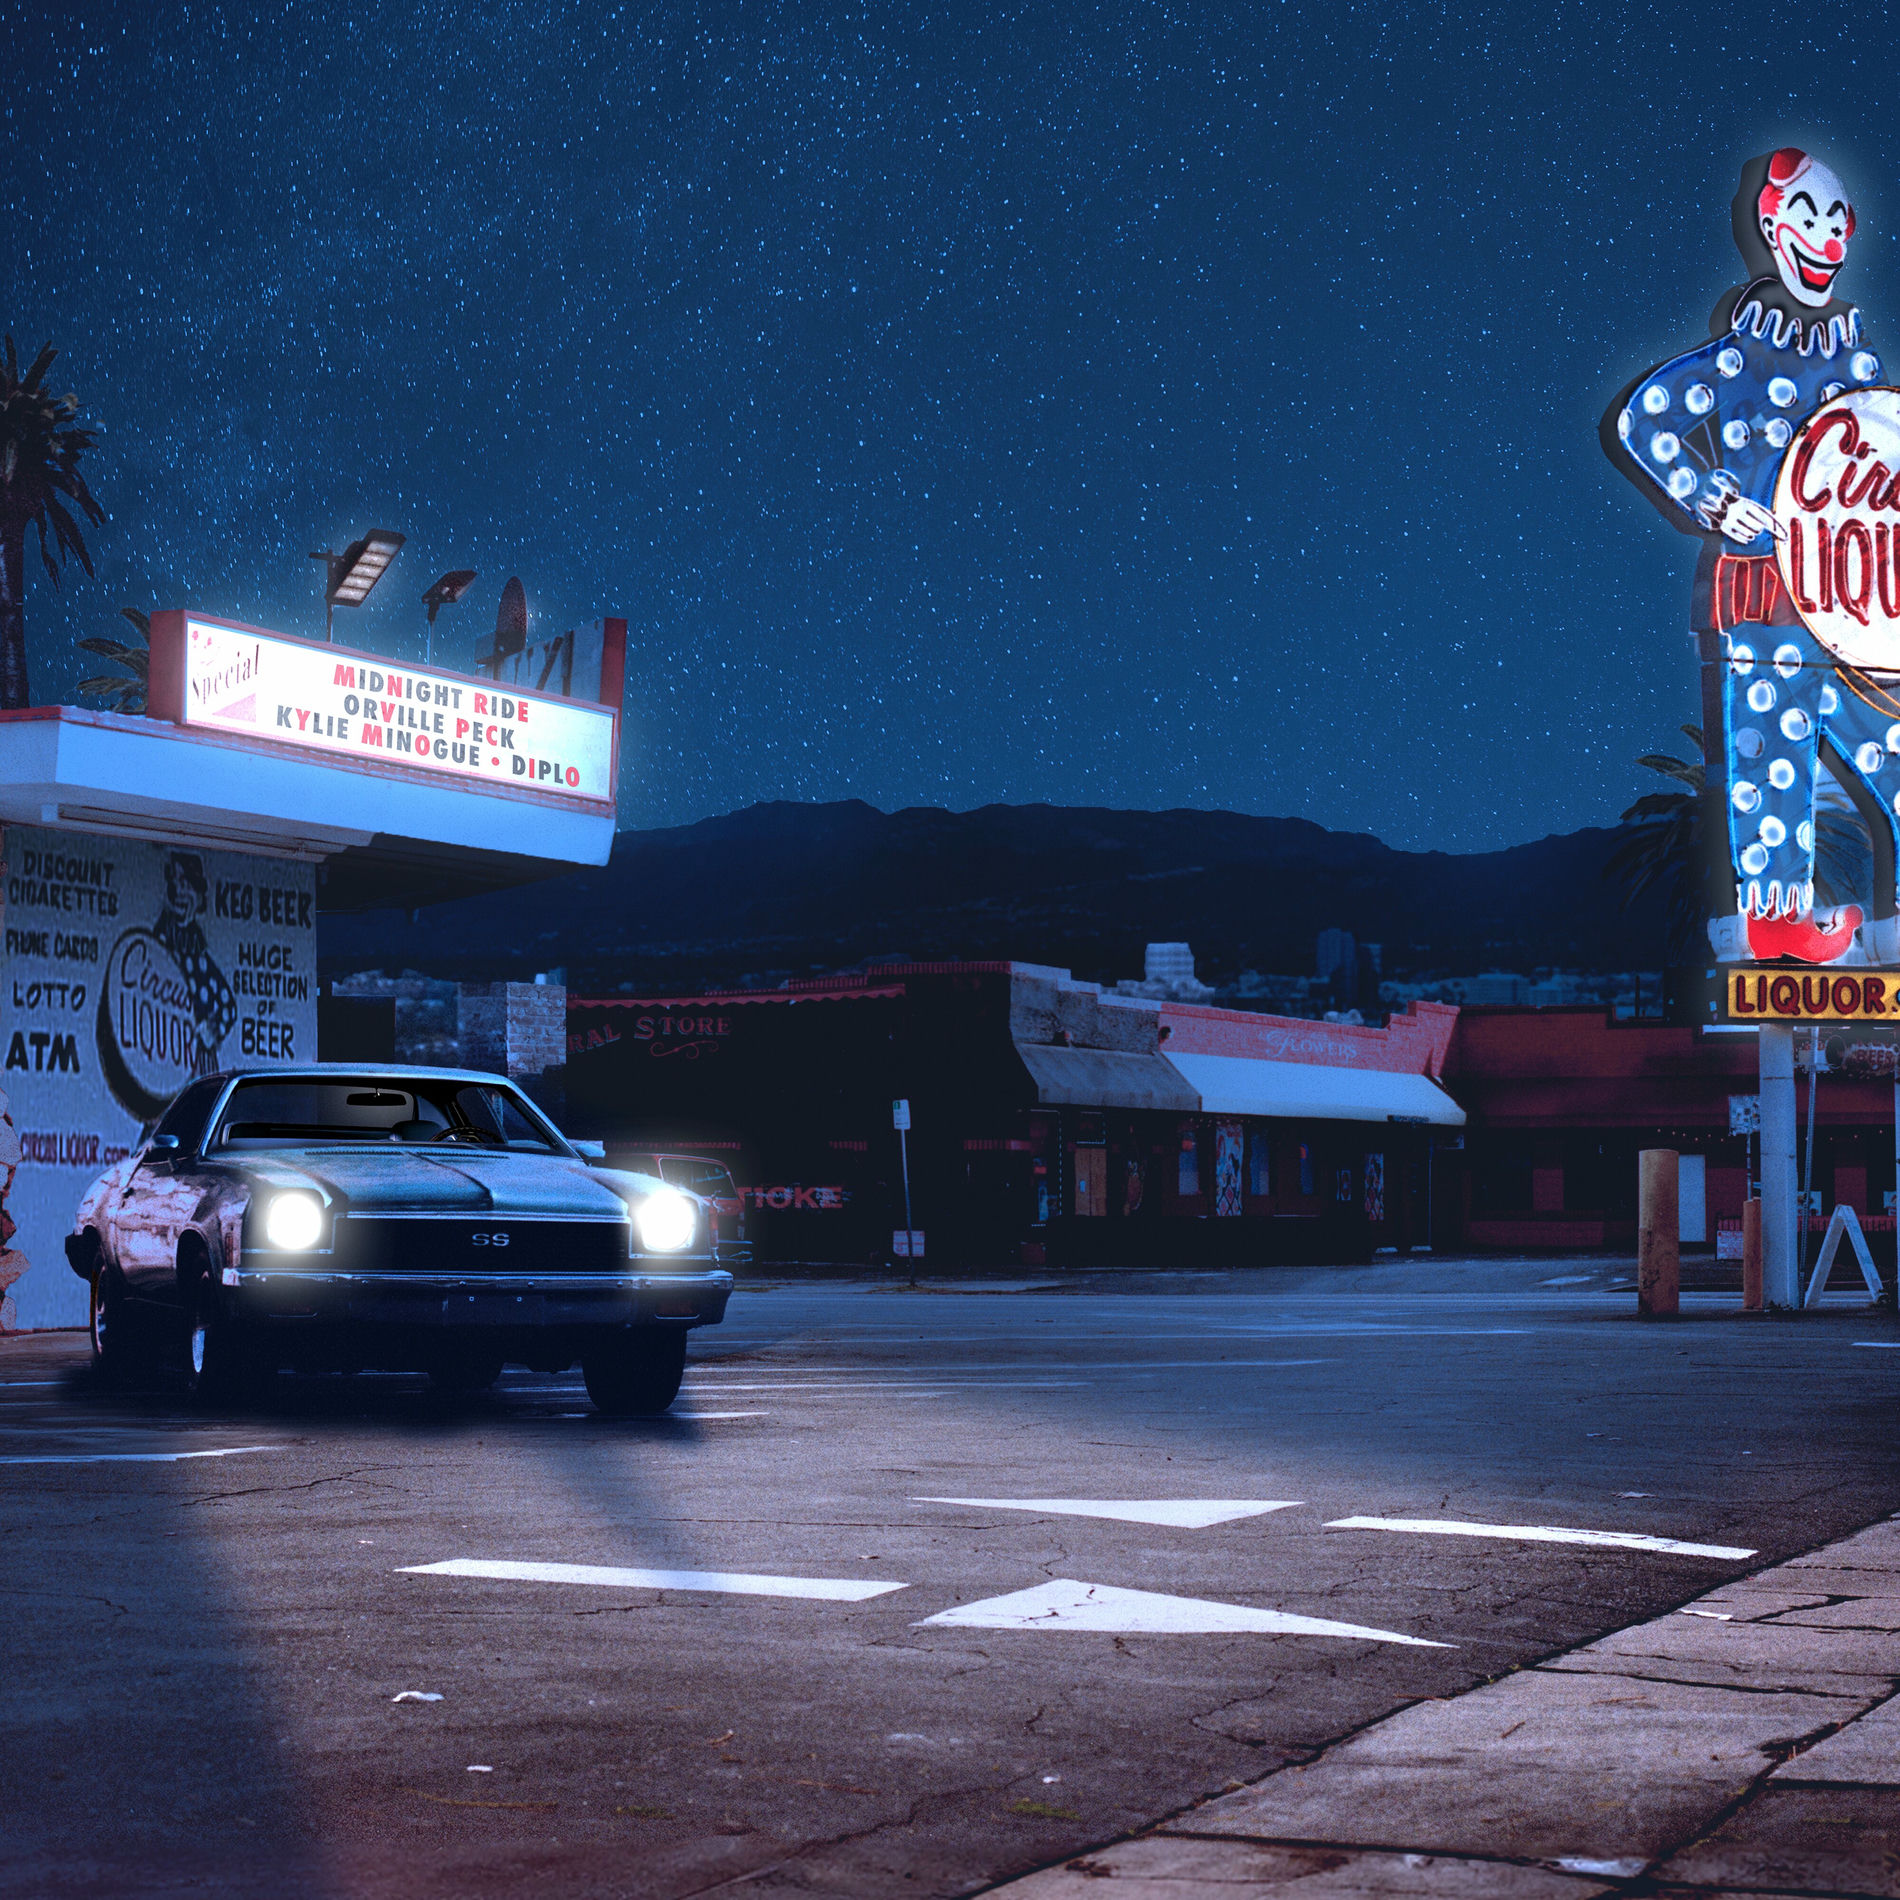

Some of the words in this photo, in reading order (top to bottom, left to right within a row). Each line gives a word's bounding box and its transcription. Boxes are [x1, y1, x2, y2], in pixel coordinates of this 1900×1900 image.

[333, 664, 463, 709] MIDNIGHT
[474, 692, 529, 723] RIDE
[343, 694, 444, 734] ORVILLE
[455, 717, 515, 750] PECK
[276, 704, 349, 740] KYLIE
[361, 723, 480, 767] MINOGUE
[512, 755, 580, 788] DIPLO
[23, 850, 114, 888] DISCOUNT
[214, 881, 253, 920] KEG
[258, 886, 312, 929] BEER
[6, 929, 49, 958] PHONE
[238, 942, 293, 972] HUGE
[13, 980, 86, 1012] LOTTO
[121, 939, 193, 1014] Circus
[232, 970, 308, 1003] SELECTION
[1736, 975, 1886, 1016] LIQUOR
[256, 1000, 276, 1016] OF
[6, 1031, 80, 1074] ATM
[120, 991, 199, 1072] LIQUOR
[241, 1017, 295, 1060] BEER
[471, 1233, 510, 1247] SS
